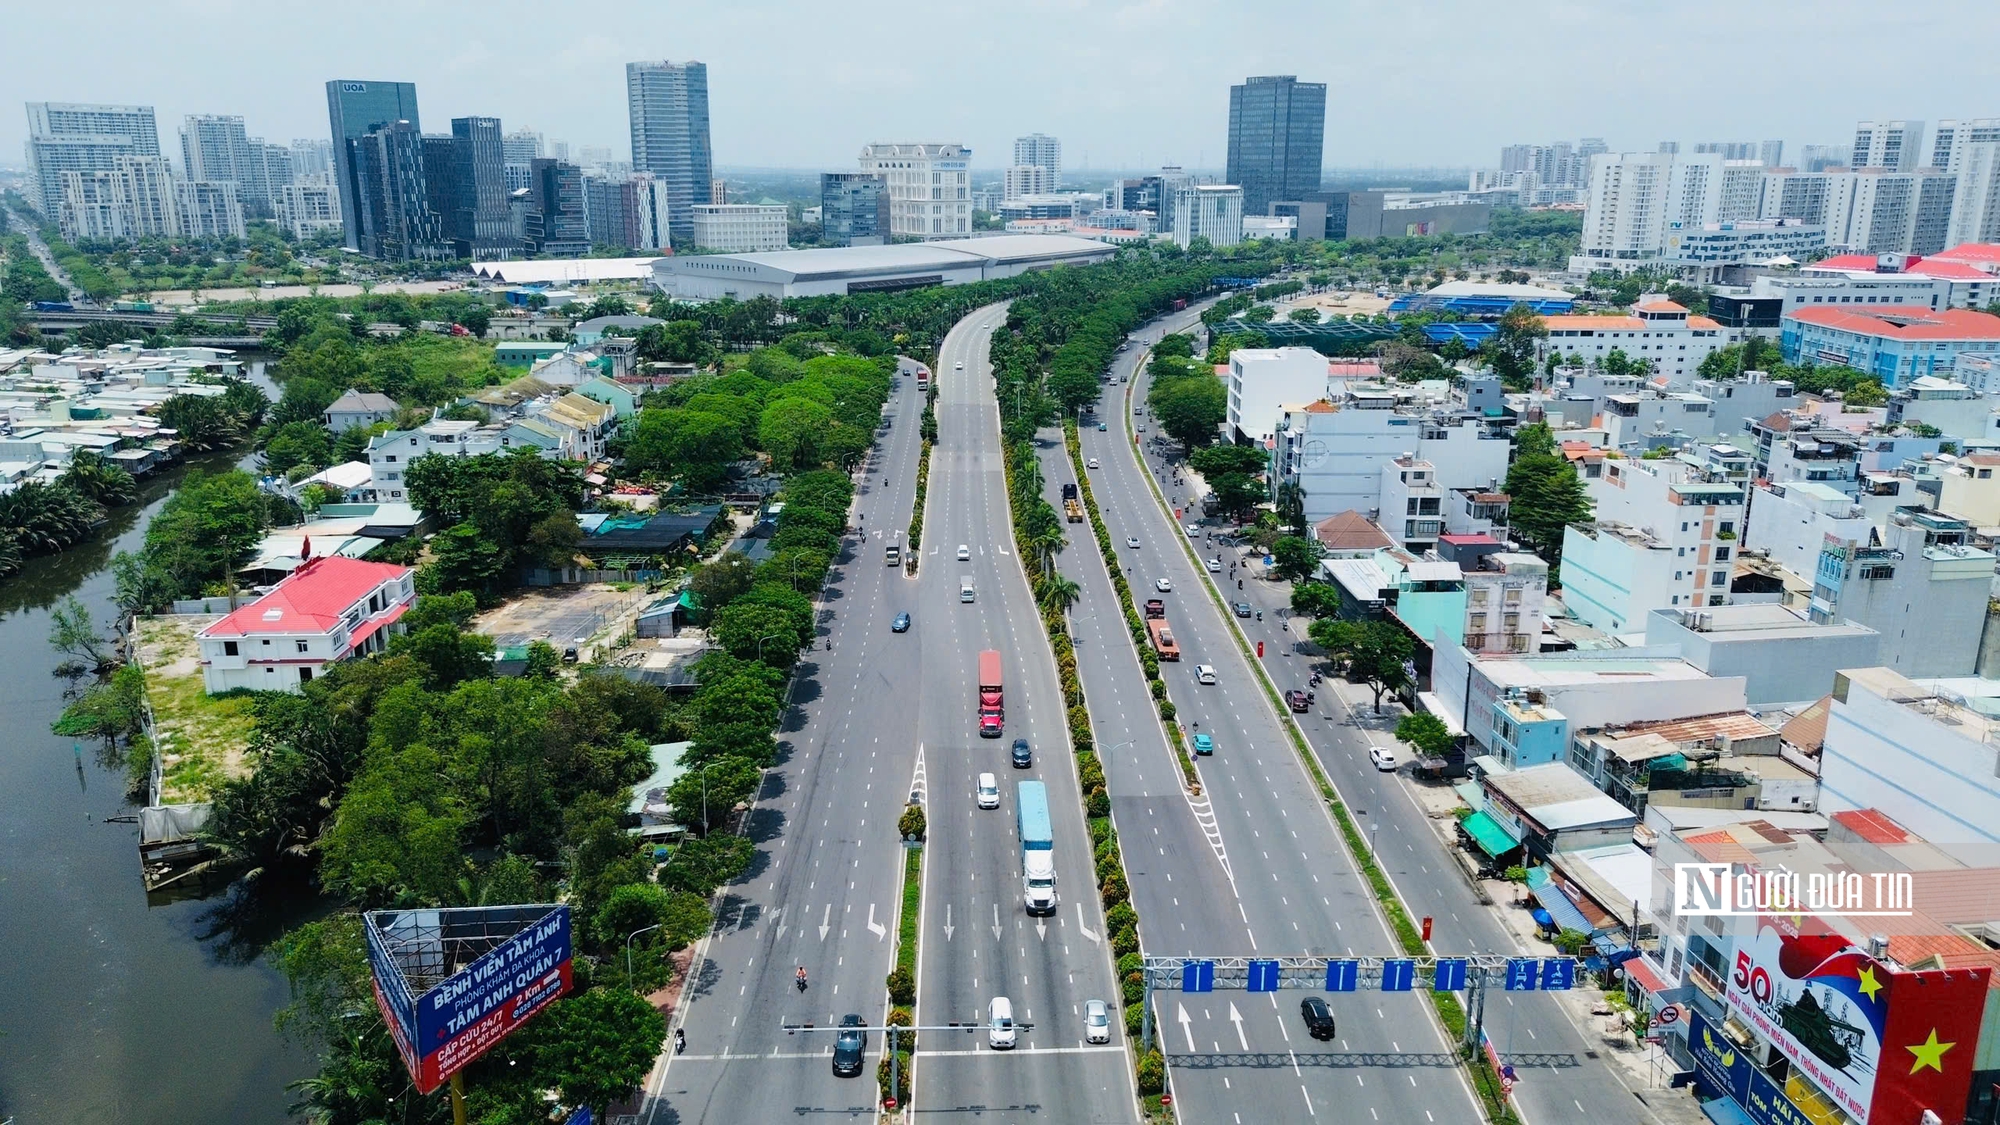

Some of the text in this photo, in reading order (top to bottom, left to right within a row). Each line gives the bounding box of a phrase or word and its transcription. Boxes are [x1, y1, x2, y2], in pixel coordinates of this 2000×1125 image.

[344, 84, 365, 92] UOA
[455, 945, 546, 1011] PHÒNG KHÁM ĐA KHOA
[1733, 948, 1774, 1006] 50
[447, 948, 562, 1034] TÂM ANH QUẬN 7
[516, 984, 540, 1006] 2 Km
[438, 1041, 458, 1061] CẤP
[481, 1010, 503, 1032] 24/7
[1785, 1040, 1799, 1061] NAM,
[1751, 1091, 1767, 1113] TÔM
[1772, 1095, 1792, 1121] HẢI
